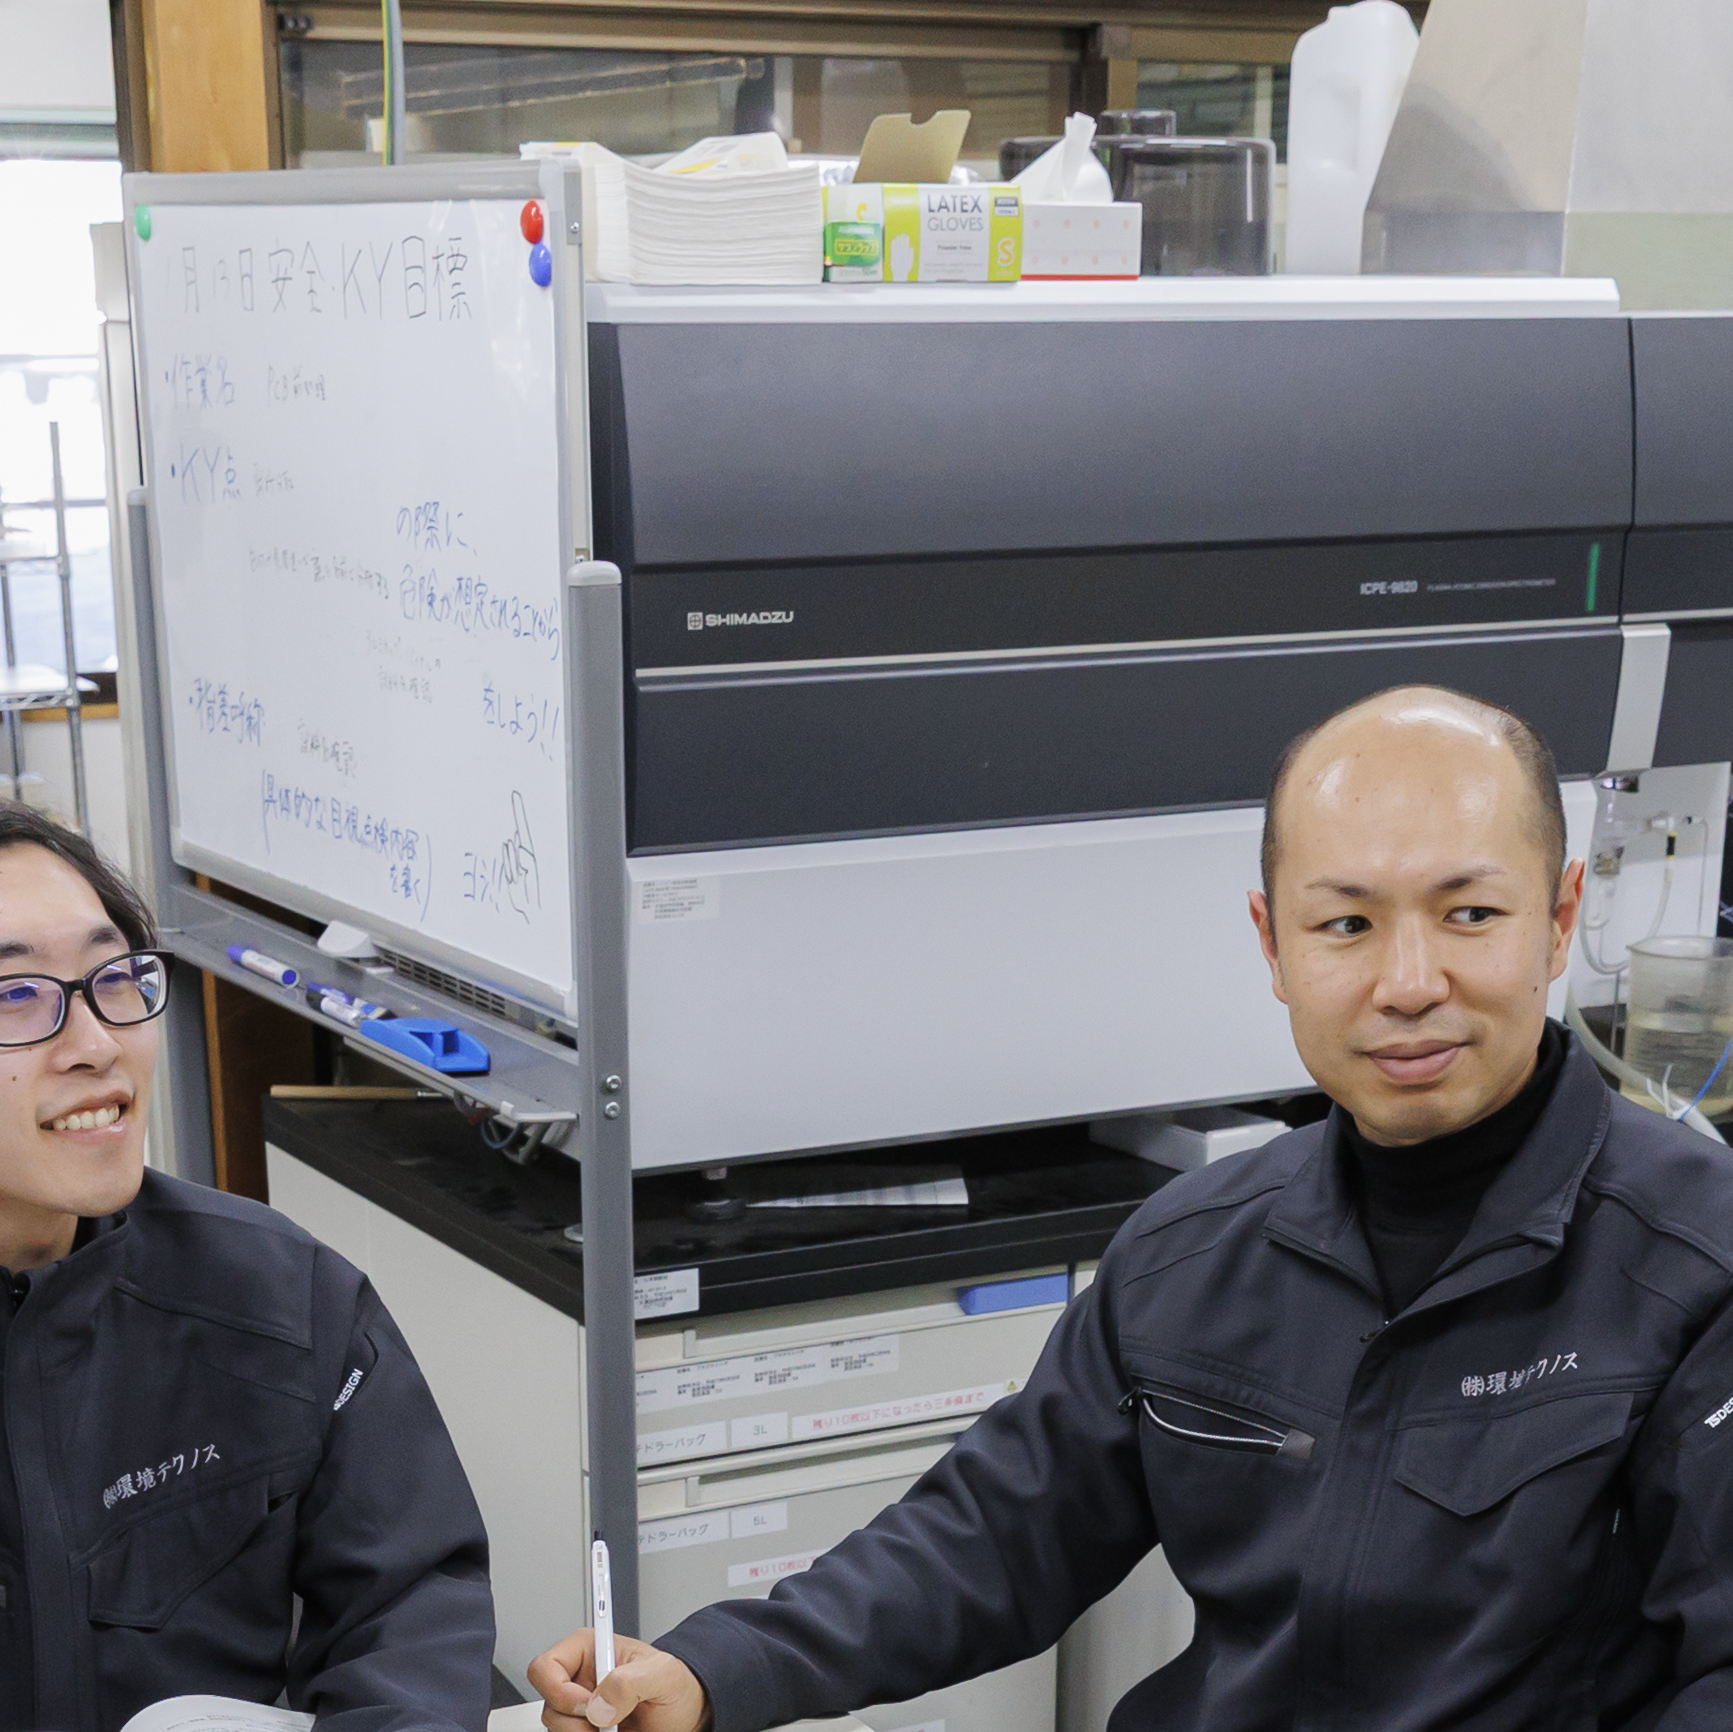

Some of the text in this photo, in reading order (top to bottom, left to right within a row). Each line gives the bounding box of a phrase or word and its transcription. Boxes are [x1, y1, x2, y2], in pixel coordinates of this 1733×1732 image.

[927, 195, 983, 213] LATEX
[927, 217, 984, 232] GLOVES
[705, 611, 794, 627] SHIMADZU
[752, 1423, 768, 1437] 3L
[752, 1515, 768, 1527] 5L
